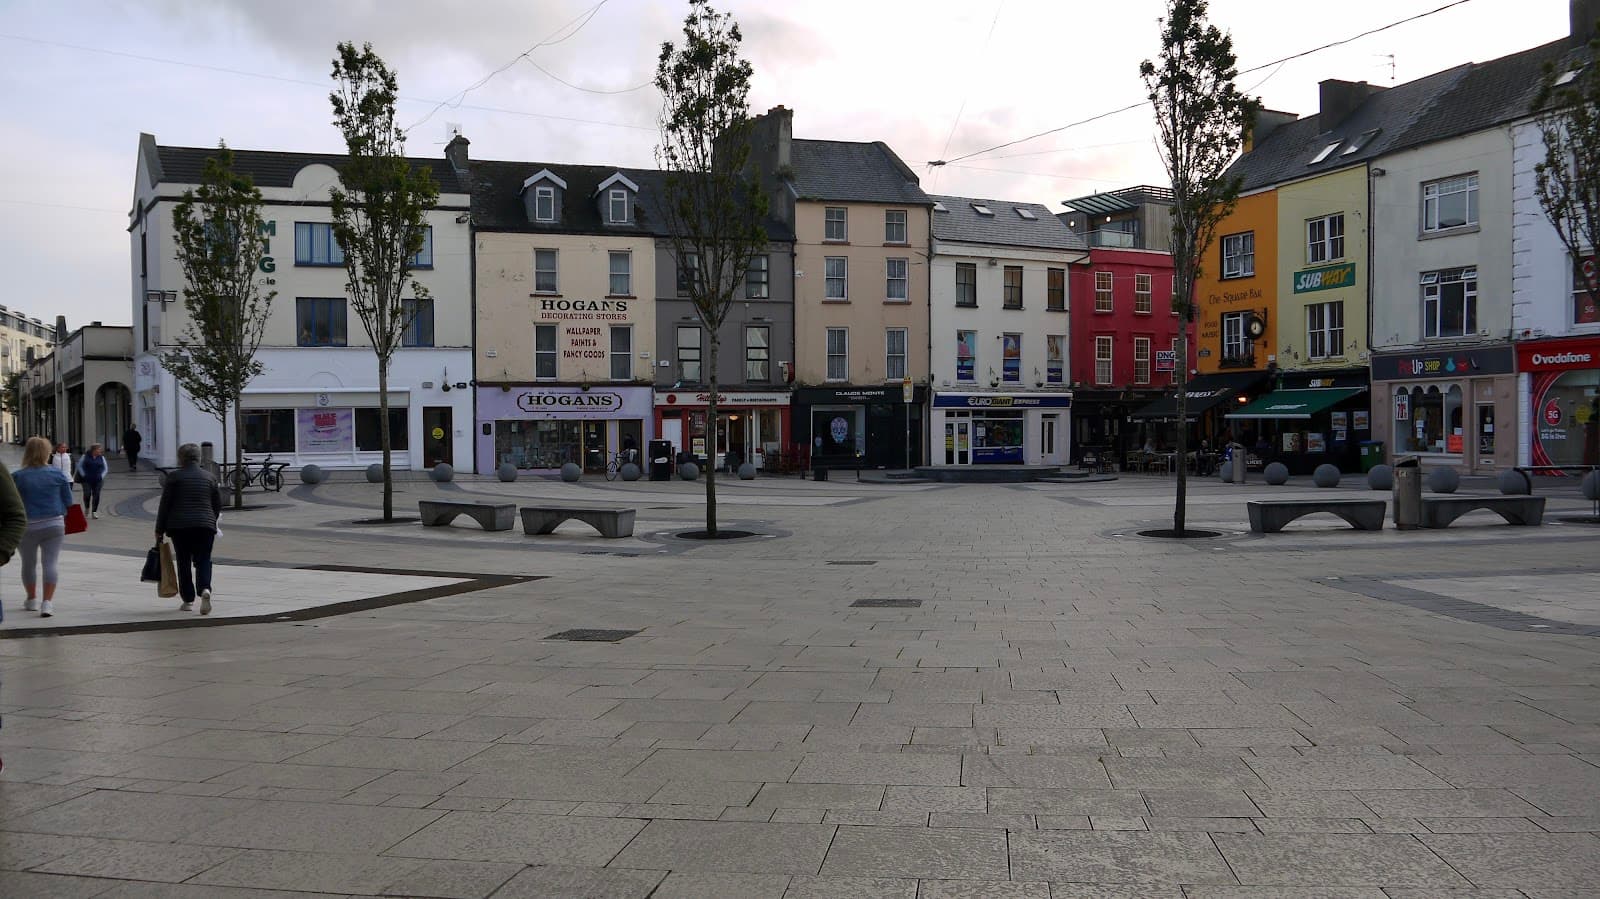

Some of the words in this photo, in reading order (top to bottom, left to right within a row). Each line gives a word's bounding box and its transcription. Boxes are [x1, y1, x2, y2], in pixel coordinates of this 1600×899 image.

[1296, 266, 1351, 290] SUBWAY
[540, 299, 627, 312] HOGANS
[541, 312, 594, 320] DECORATING
[595, 313, 627, 321] STORES
[571, 338, 591, 347] PAINTS
[563, 350, 583, 359] FANCY
[583, 350, 605, 359] GOODS
[1157, 351, 1175, 359] DNG
[1542, 351, 1592, 365] vodafone
[1424, 360, 1441, 371] SHOP
[527, 395, 613, 406] HOGANS
[1547, 410, 1559, 419] 5G
